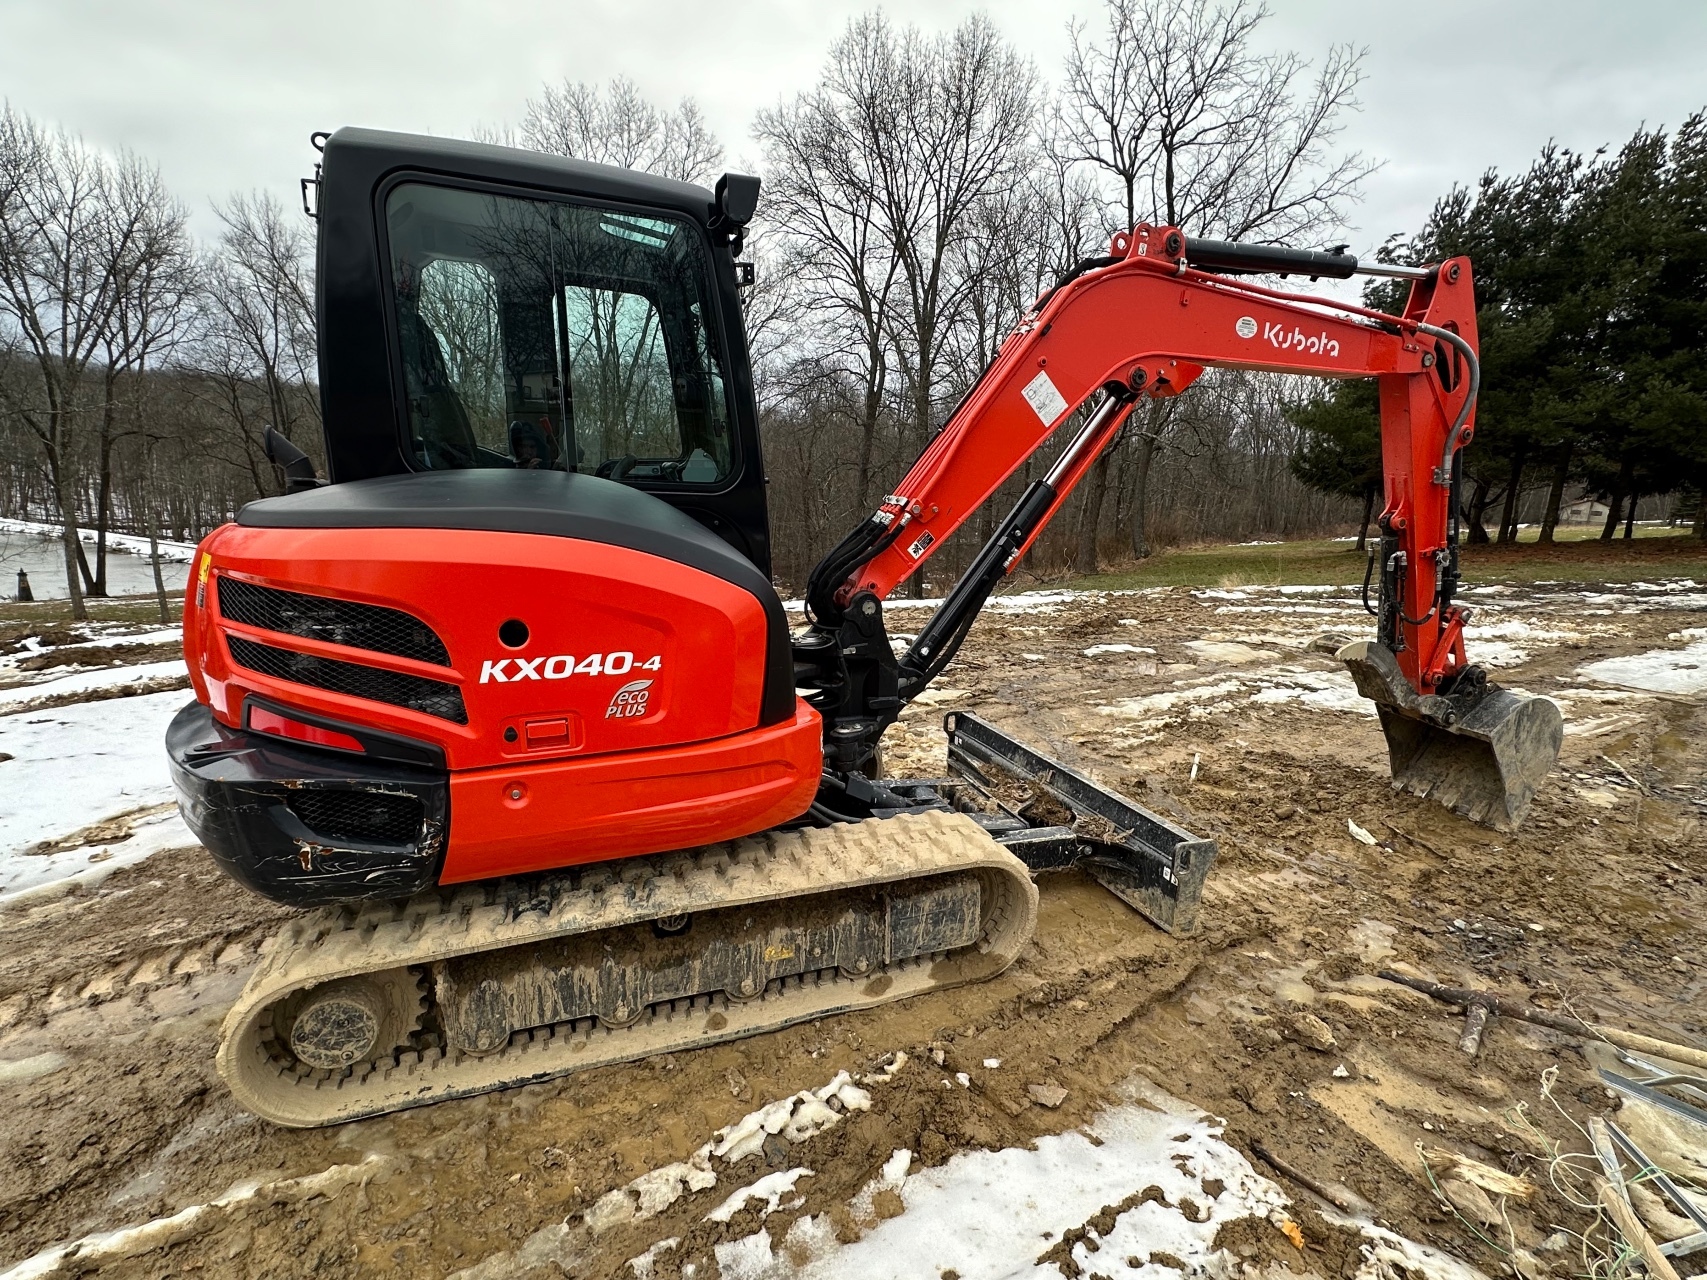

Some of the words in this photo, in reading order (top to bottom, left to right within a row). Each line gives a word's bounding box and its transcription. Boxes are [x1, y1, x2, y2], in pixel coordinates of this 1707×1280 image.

[1263, 321, 1339, 357] Kubota
[479, 651, 661, 684] KX040-4
[605, 703, 647, 719] PLUS
